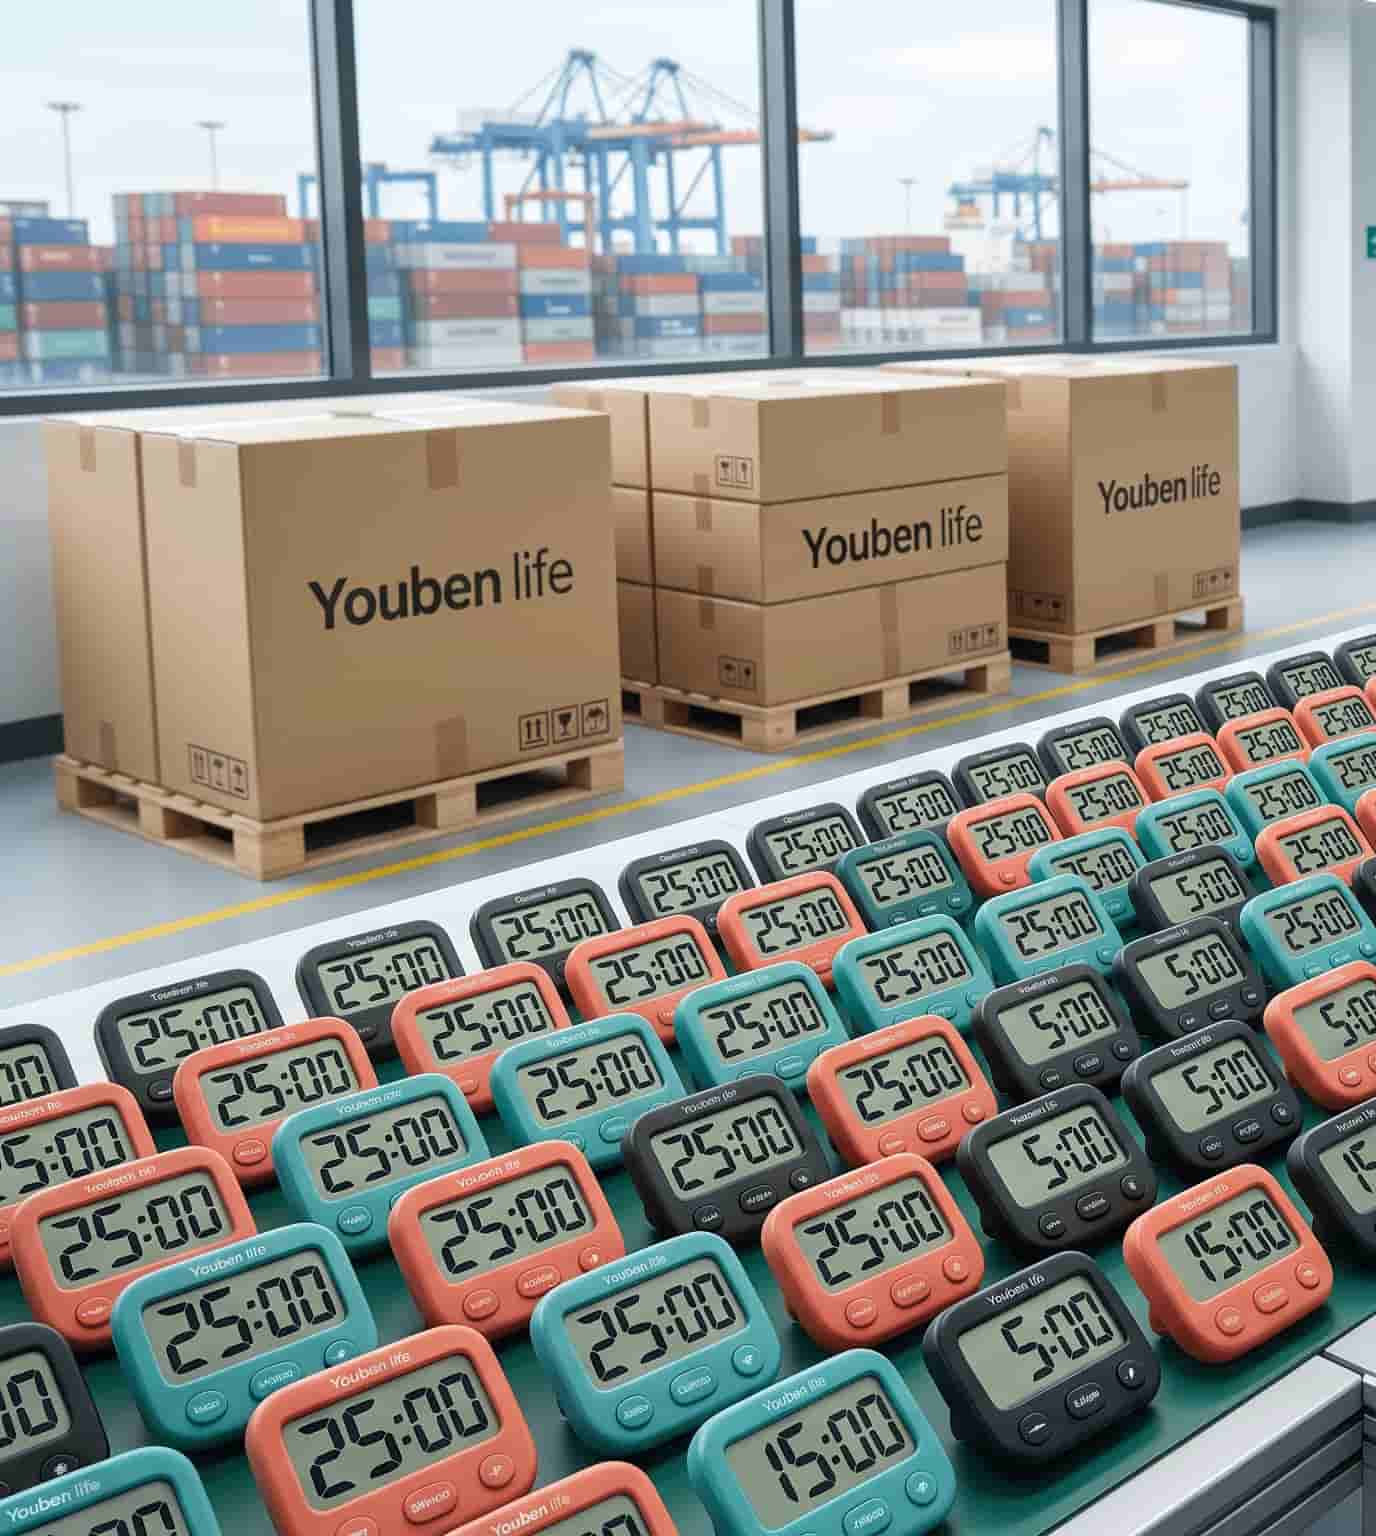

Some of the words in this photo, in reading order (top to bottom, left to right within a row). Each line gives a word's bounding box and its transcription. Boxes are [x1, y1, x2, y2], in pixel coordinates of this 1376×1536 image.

[1097, 472, 1187, 514] Youben
[1191, 464, 1221, 499] life
[801, 518, 932, 568] Youben
[939, 505, 983, 547] life
[307, 564, 502, 630] Youben
[513, 547, 573, 600] life
[1219, 686, 1273, 719] 25:00
[1287, 666, 1338, 697] 25:00
[1141, 708, 1199, 743] 25:00
[1246, 725, 1300, 762] 25:00
[1317, 702, 1374, 736] 25:00
[975, 759, 1042, 800] 25:00
[1060, 732, 1122, 770] 25:00
[1157, 750, 1223, 791] 25:00
[882, 789, 951, 832] 25:00
[1071, 779, 1139, 822] 25:00
[1253, 778, 1318, 819] 25:00
[773, 823, 851, 869] 25:00
[974, 812, 1052, 859] 25:00
[1285, 826, 1358, 874] 25:00
[644, 861, 738, 913] 25:00
[863, 852, 947, 903] 25:00
[1176, 865, 1244, 913] 5:00
[500, 902, 599, 958] 25:00
[749, 896, 847, 953] 25:00
[1006, 899, 1098, 956] 25:00
[1273, 894, 1358, 951] 25:00
[327, 946, 449, 1011] 25:00
[597, 942, 704, 1004] 25:00
[866, 942, 967, 1002] 25:00
[1164, 942, 1238, 996] 5:00
[129, 998, 263, 1067] 25:00
[427, 992, 547, 1061] 25:00
[708, 992, 819, 1058] 25:00
[1028, 991, 1110, 1049] 5:00
[211, 1048, 354, 1127] 25:00
[528, 1044, 656, 1120] 25:00
[845, 1046, 963, 1122] 25:00
[1185, 1049, 1274, 1115] 5:00
[0, 1117, 128, 1195] 5:00
[312, 1108, 459, 1194] 25:00
[662, 1108, 794, 1191] 25:00
[1022, 1117, 1118, 1189] 5:00
[51, 1184, 223, 1281] 25:00
[430, 1178, 586, 1274] 25:00
[803, 1189, 945, 1286] 25:00
[1185, 1199, 1292, 1283] 15:00
[156, 1264, 338, 1375] 25:00
[577, 1273, 736, 1381] 25:00
[1002, 1291, 1114, 1383] 5:00
[299, 1372, 488, 1499] 25:00
[764, 1394, 905, 1502] 15:00
[5, 1488, 73, 1524] Youben
[74, 1478, 100, 1502] life
